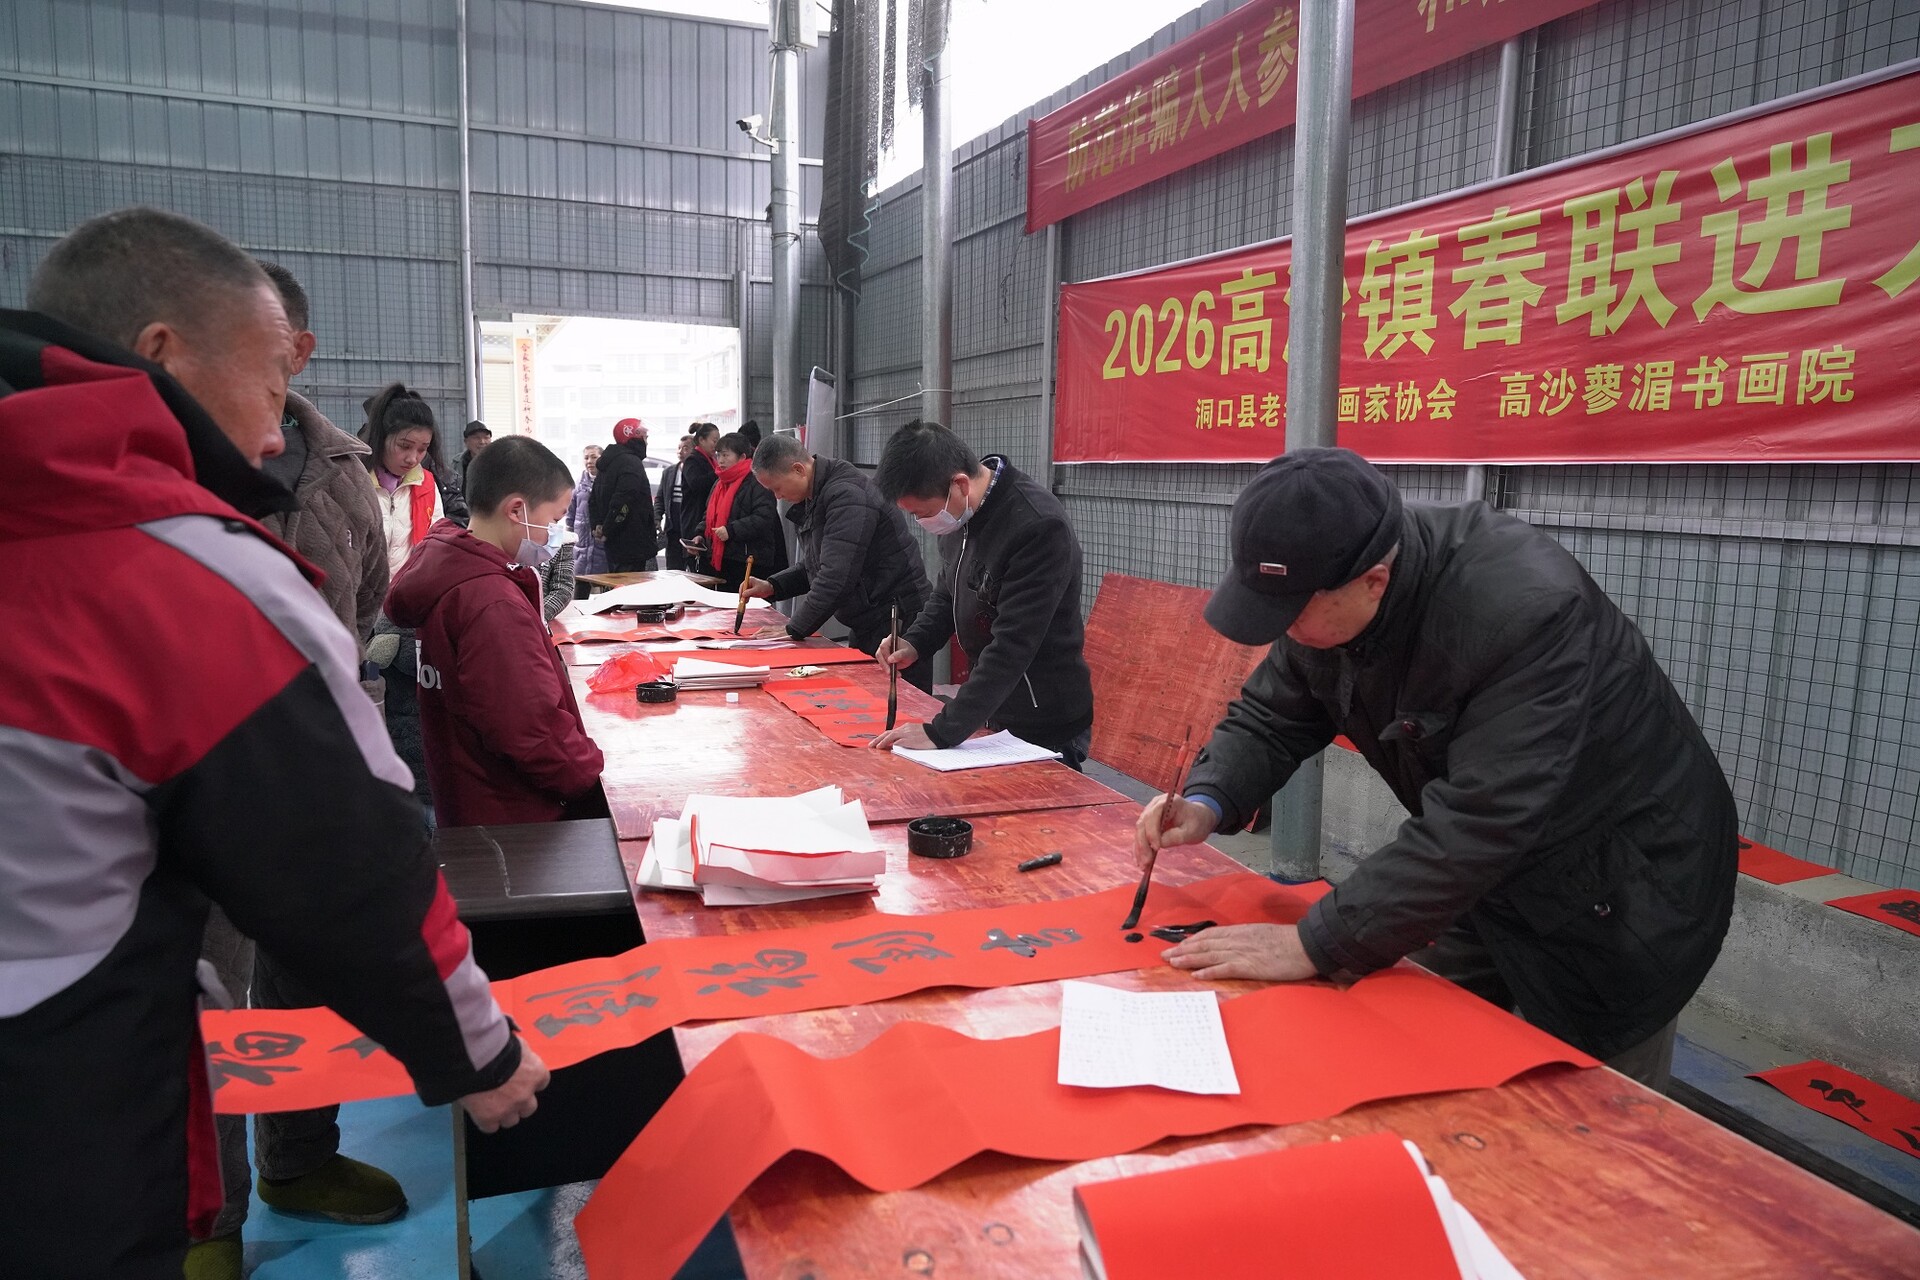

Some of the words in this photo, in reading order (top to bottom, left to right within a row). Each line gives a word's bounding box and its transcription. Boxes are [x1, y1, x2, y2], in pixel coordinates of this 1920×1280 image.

[1102, 122, 1920, 380] 2026高镇春联进
[1195, 378, 1457, 430] 洞口县老画家协会
[1498, 344, 1857, 418] 高沙蓼湄书画院
